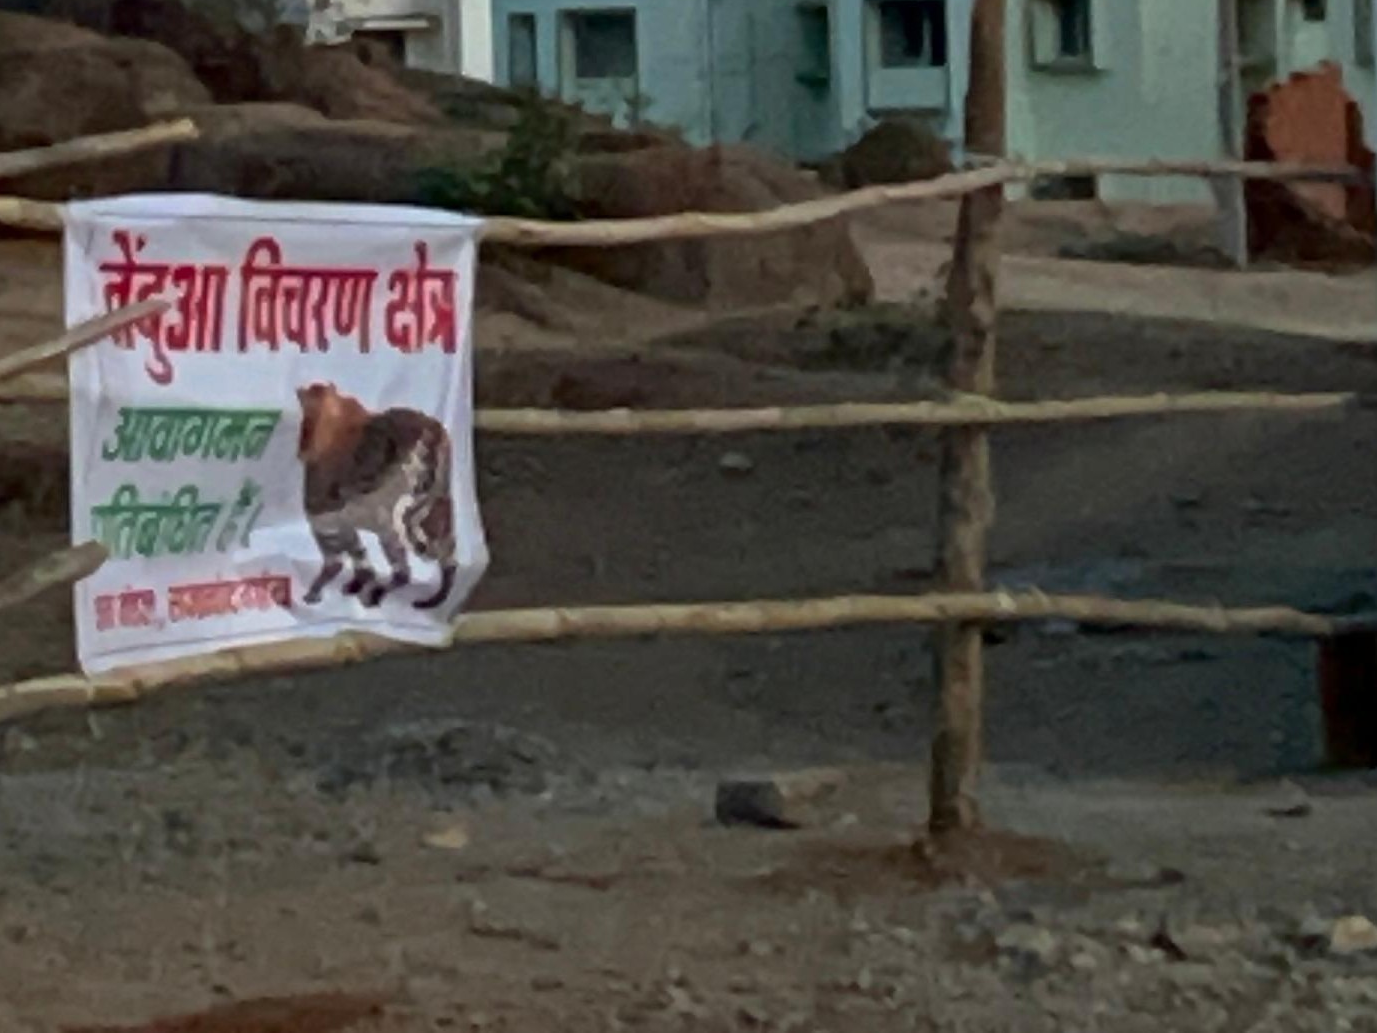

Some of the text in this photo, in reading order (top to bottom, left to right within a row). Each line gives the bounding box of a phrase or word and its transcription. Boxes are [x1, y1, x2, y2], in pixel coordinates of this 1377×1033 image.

[99, 230, 458, 385] तेंदुआ विचरण क्षेत्र
